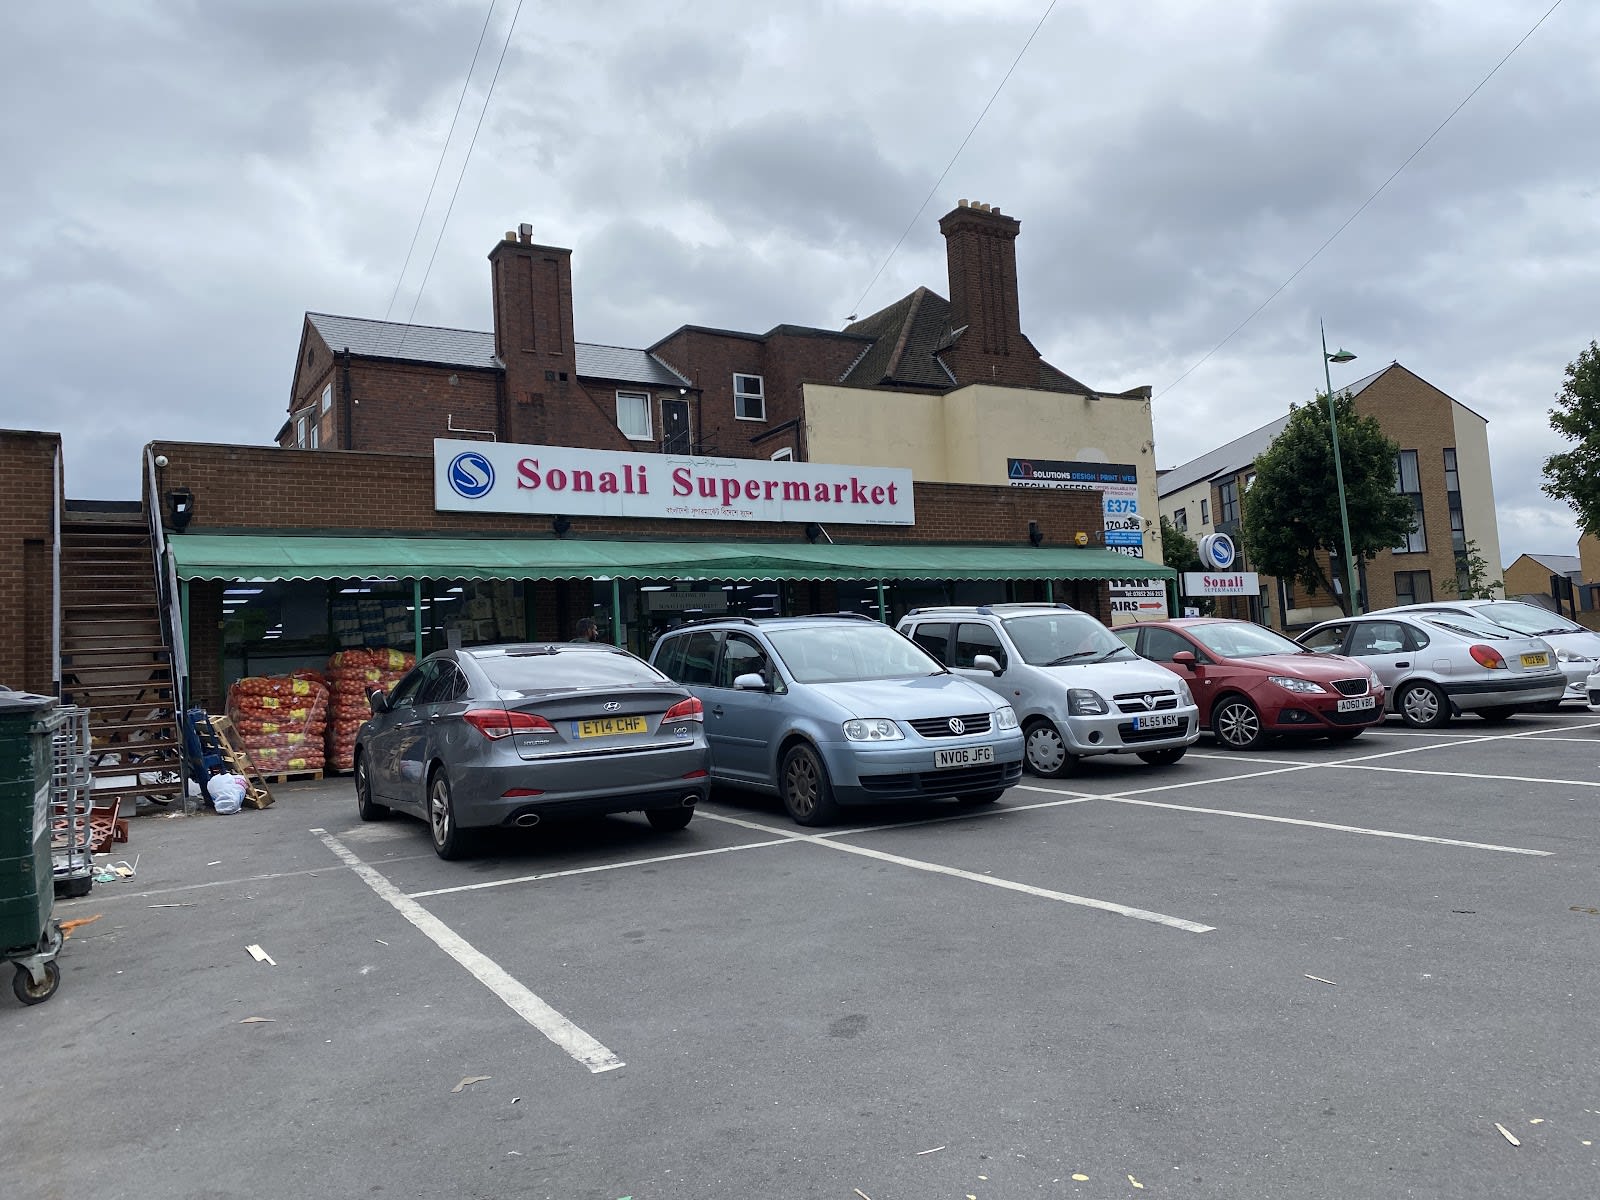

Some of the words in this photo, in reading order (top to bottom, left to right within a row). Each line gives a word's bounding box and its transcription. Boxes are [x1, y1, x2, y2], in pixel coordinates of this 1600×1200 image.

[517, 458, 649, 494] Sonali
[672, 467, 898, 505] Supermarket
[1033, 471, 1071, 479] SOLUTIONS
[1071, 472, 1096, 480] DESIGN
[1107, 499, 1137, 513] £375
[1106, 521, 1120, 530] 170
[1204, 575, 1244, 587] Sonali
[1341, 699, 1360, 710] AO60
[583, 720, 613, 734] ET14
[616, 718, 641, 731] CHF
[1139, 716, 1160, 727] BL55
[1162, 715, 1177, 725] WSK
[940, 750, 969, 765] NV06
[972, 748, 990, 761] JFG
